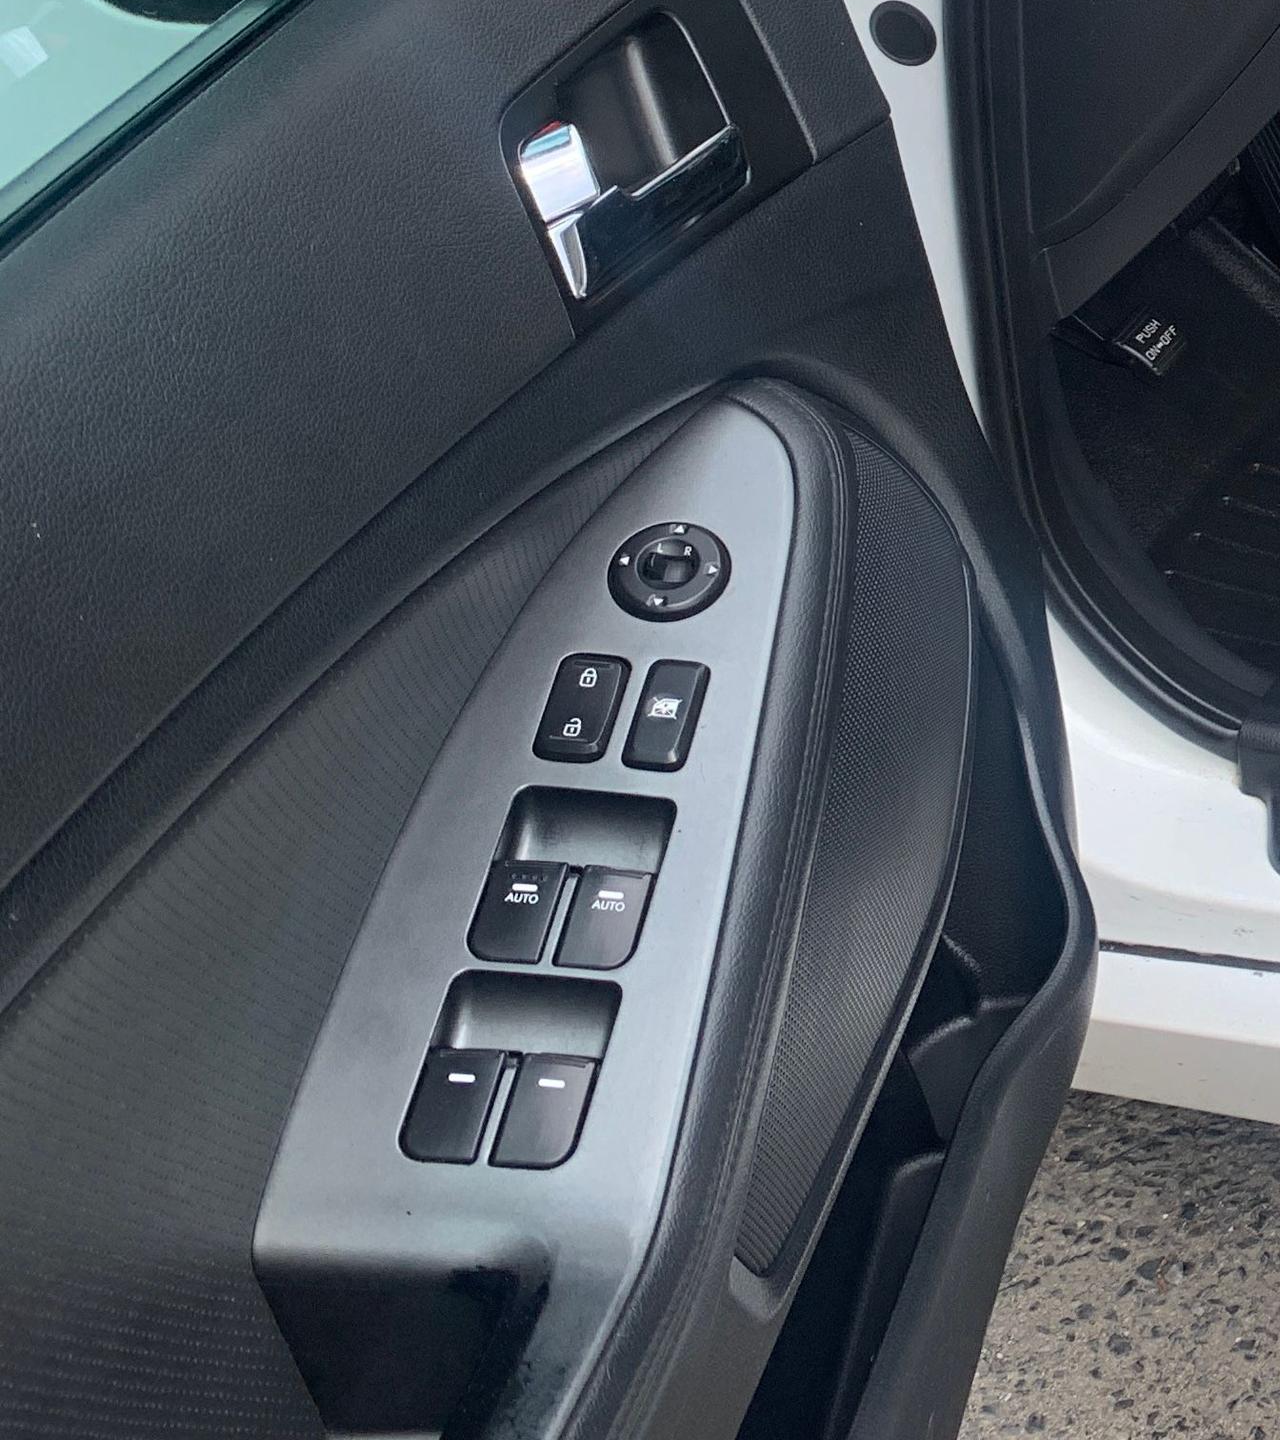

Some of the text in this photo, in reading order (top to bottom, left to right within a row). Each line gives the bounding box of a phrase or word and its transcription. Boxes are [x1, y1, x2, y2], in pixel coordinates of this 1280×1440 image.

[1135, 319, 1162, 344] PUSH
[657, 543, 663, 553] L
[683, 545, 692, 556] R
[504, 892, 539, 905] AUTO
[591, 899, 625, 912] AUTO
